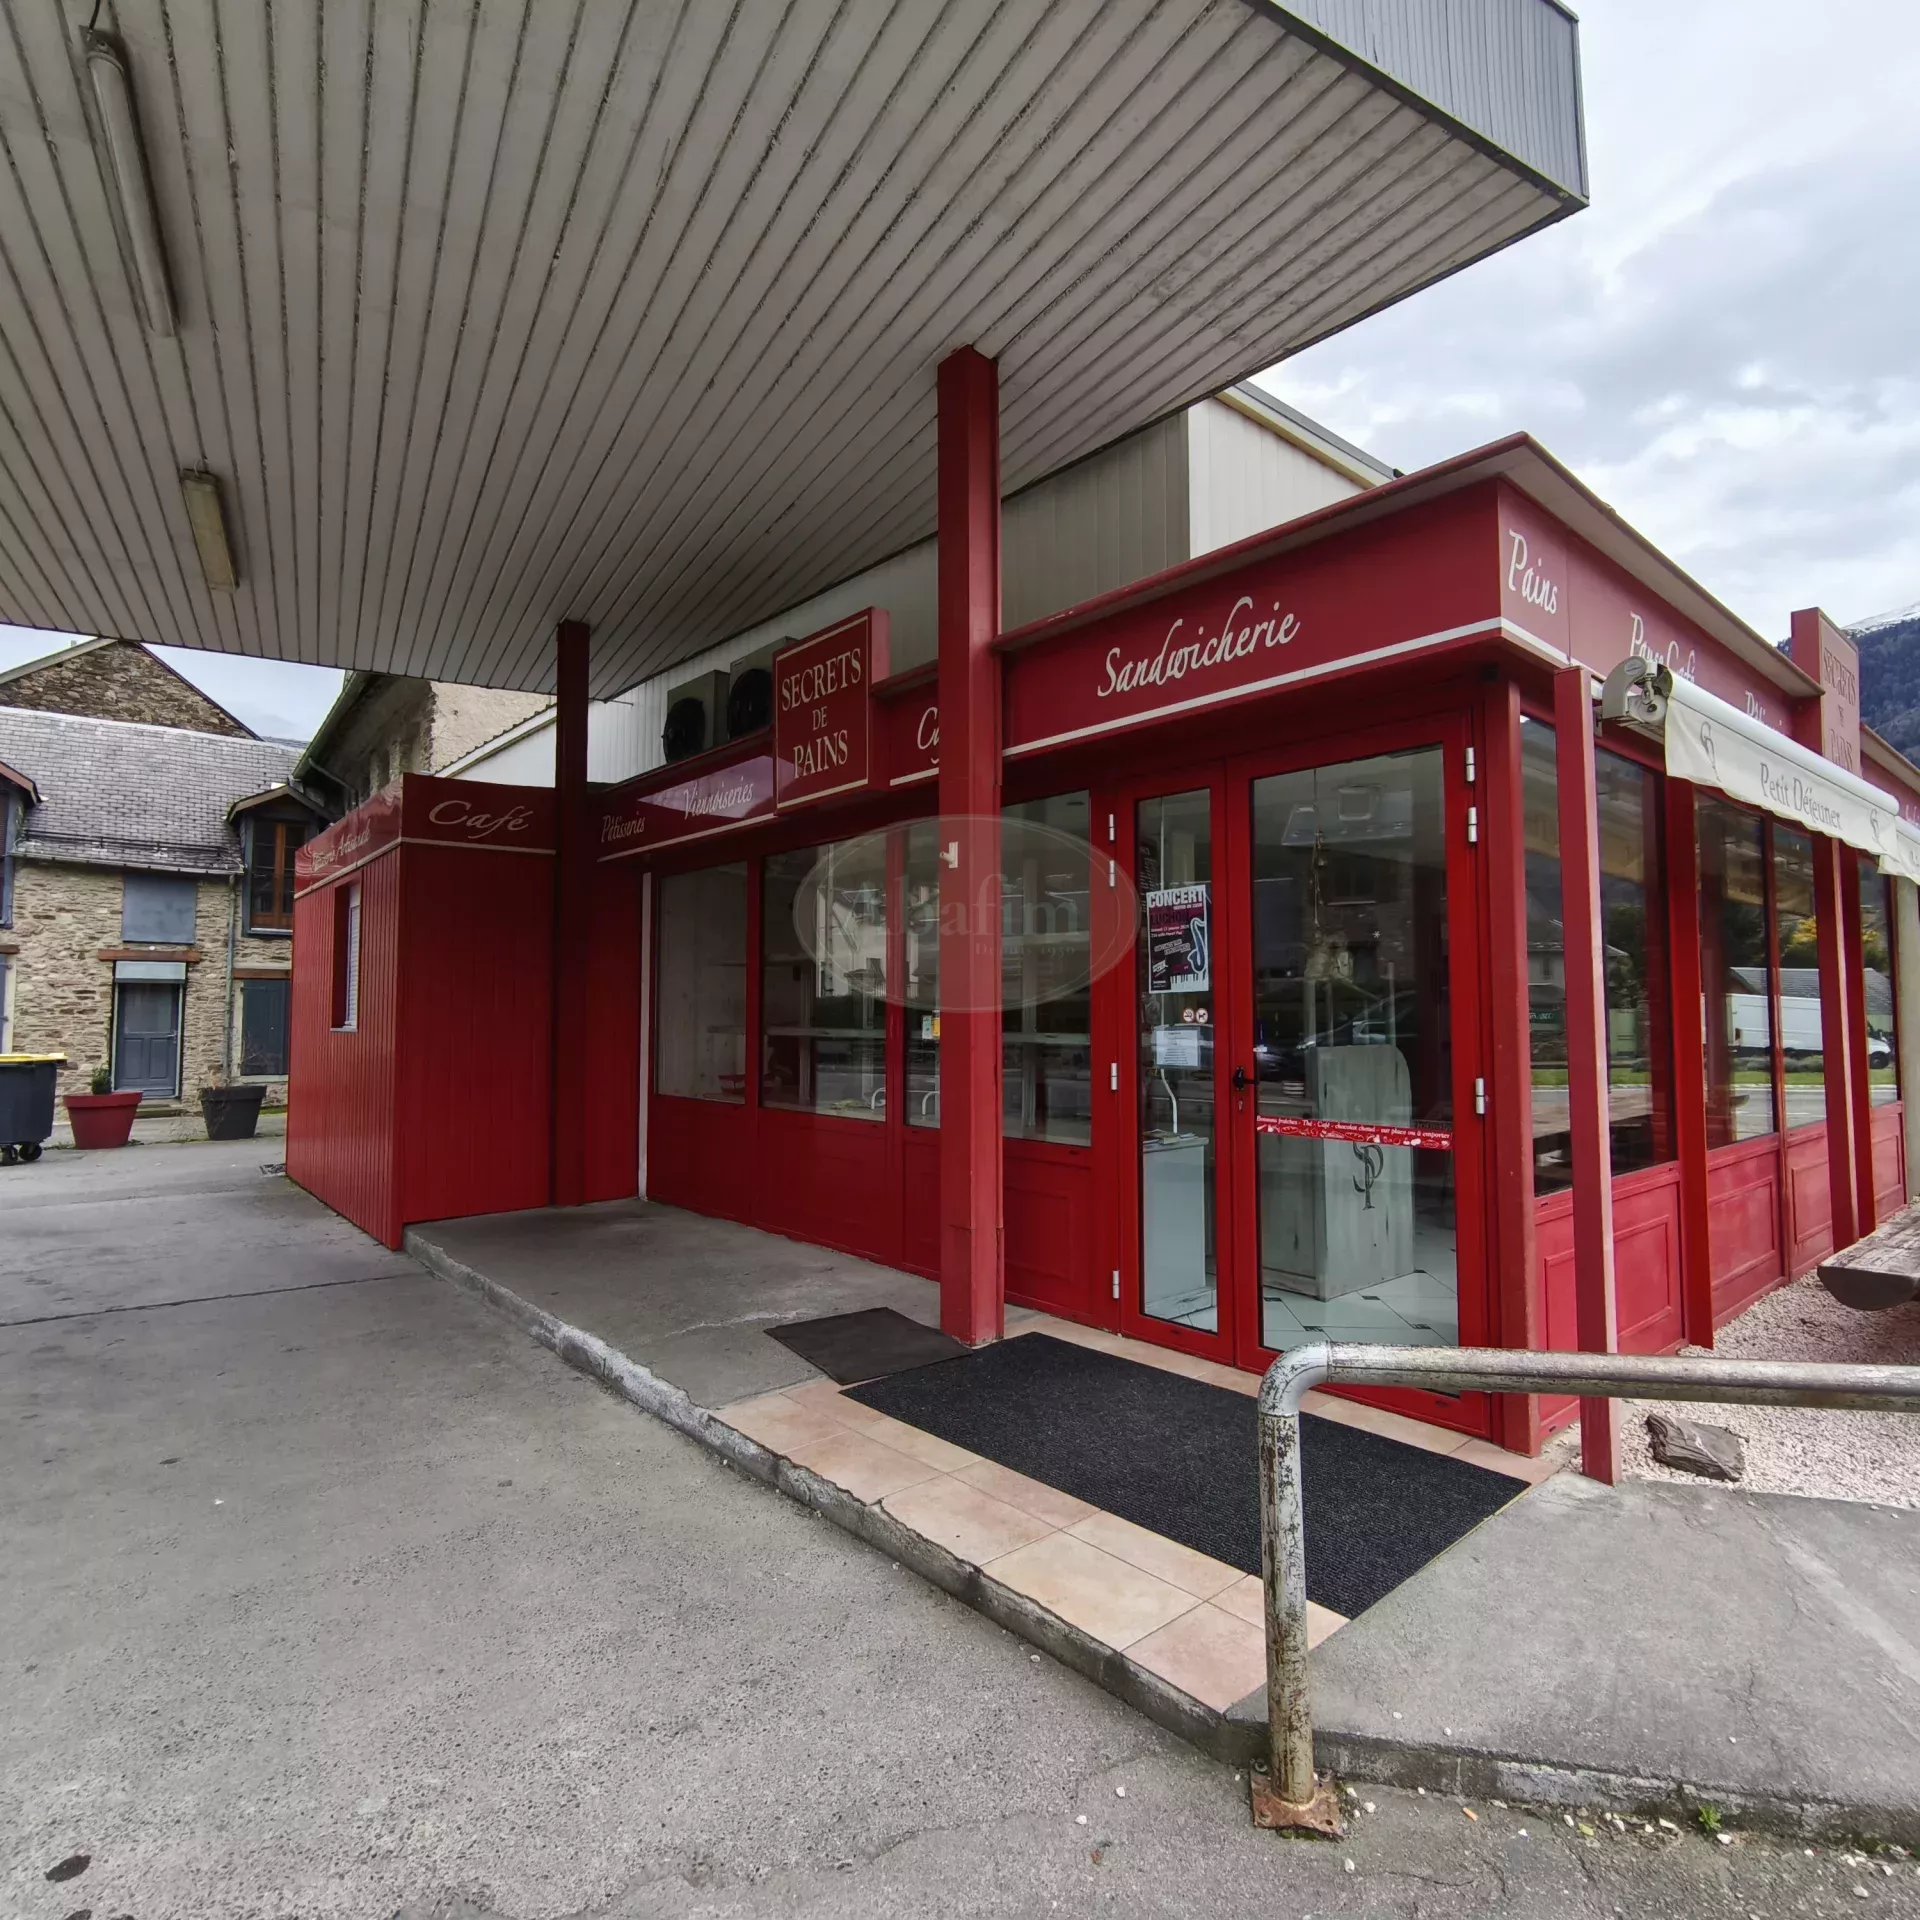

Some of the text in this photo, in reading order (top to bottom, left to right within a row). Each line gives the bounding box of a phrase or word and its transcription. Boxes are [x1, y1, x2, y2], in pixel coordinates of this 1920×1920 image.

[1507, 528, 1558, 615] Pains
[1097, 596, 1301, 697] Sandwicherie
[781, 648, 861, 711] SECRETS
[811, 705, 828, 731] DE
[793, 729, 848, 779] PAINS
[428, 800, 534, 839] Café
[683, 776, 755, 820] Viennoiseries
[1760, 762, 1791, 808] Petit
[1793, 777, 1843, 830] Déjeuner
[1149, 888, 1204, 908] CONCERT
